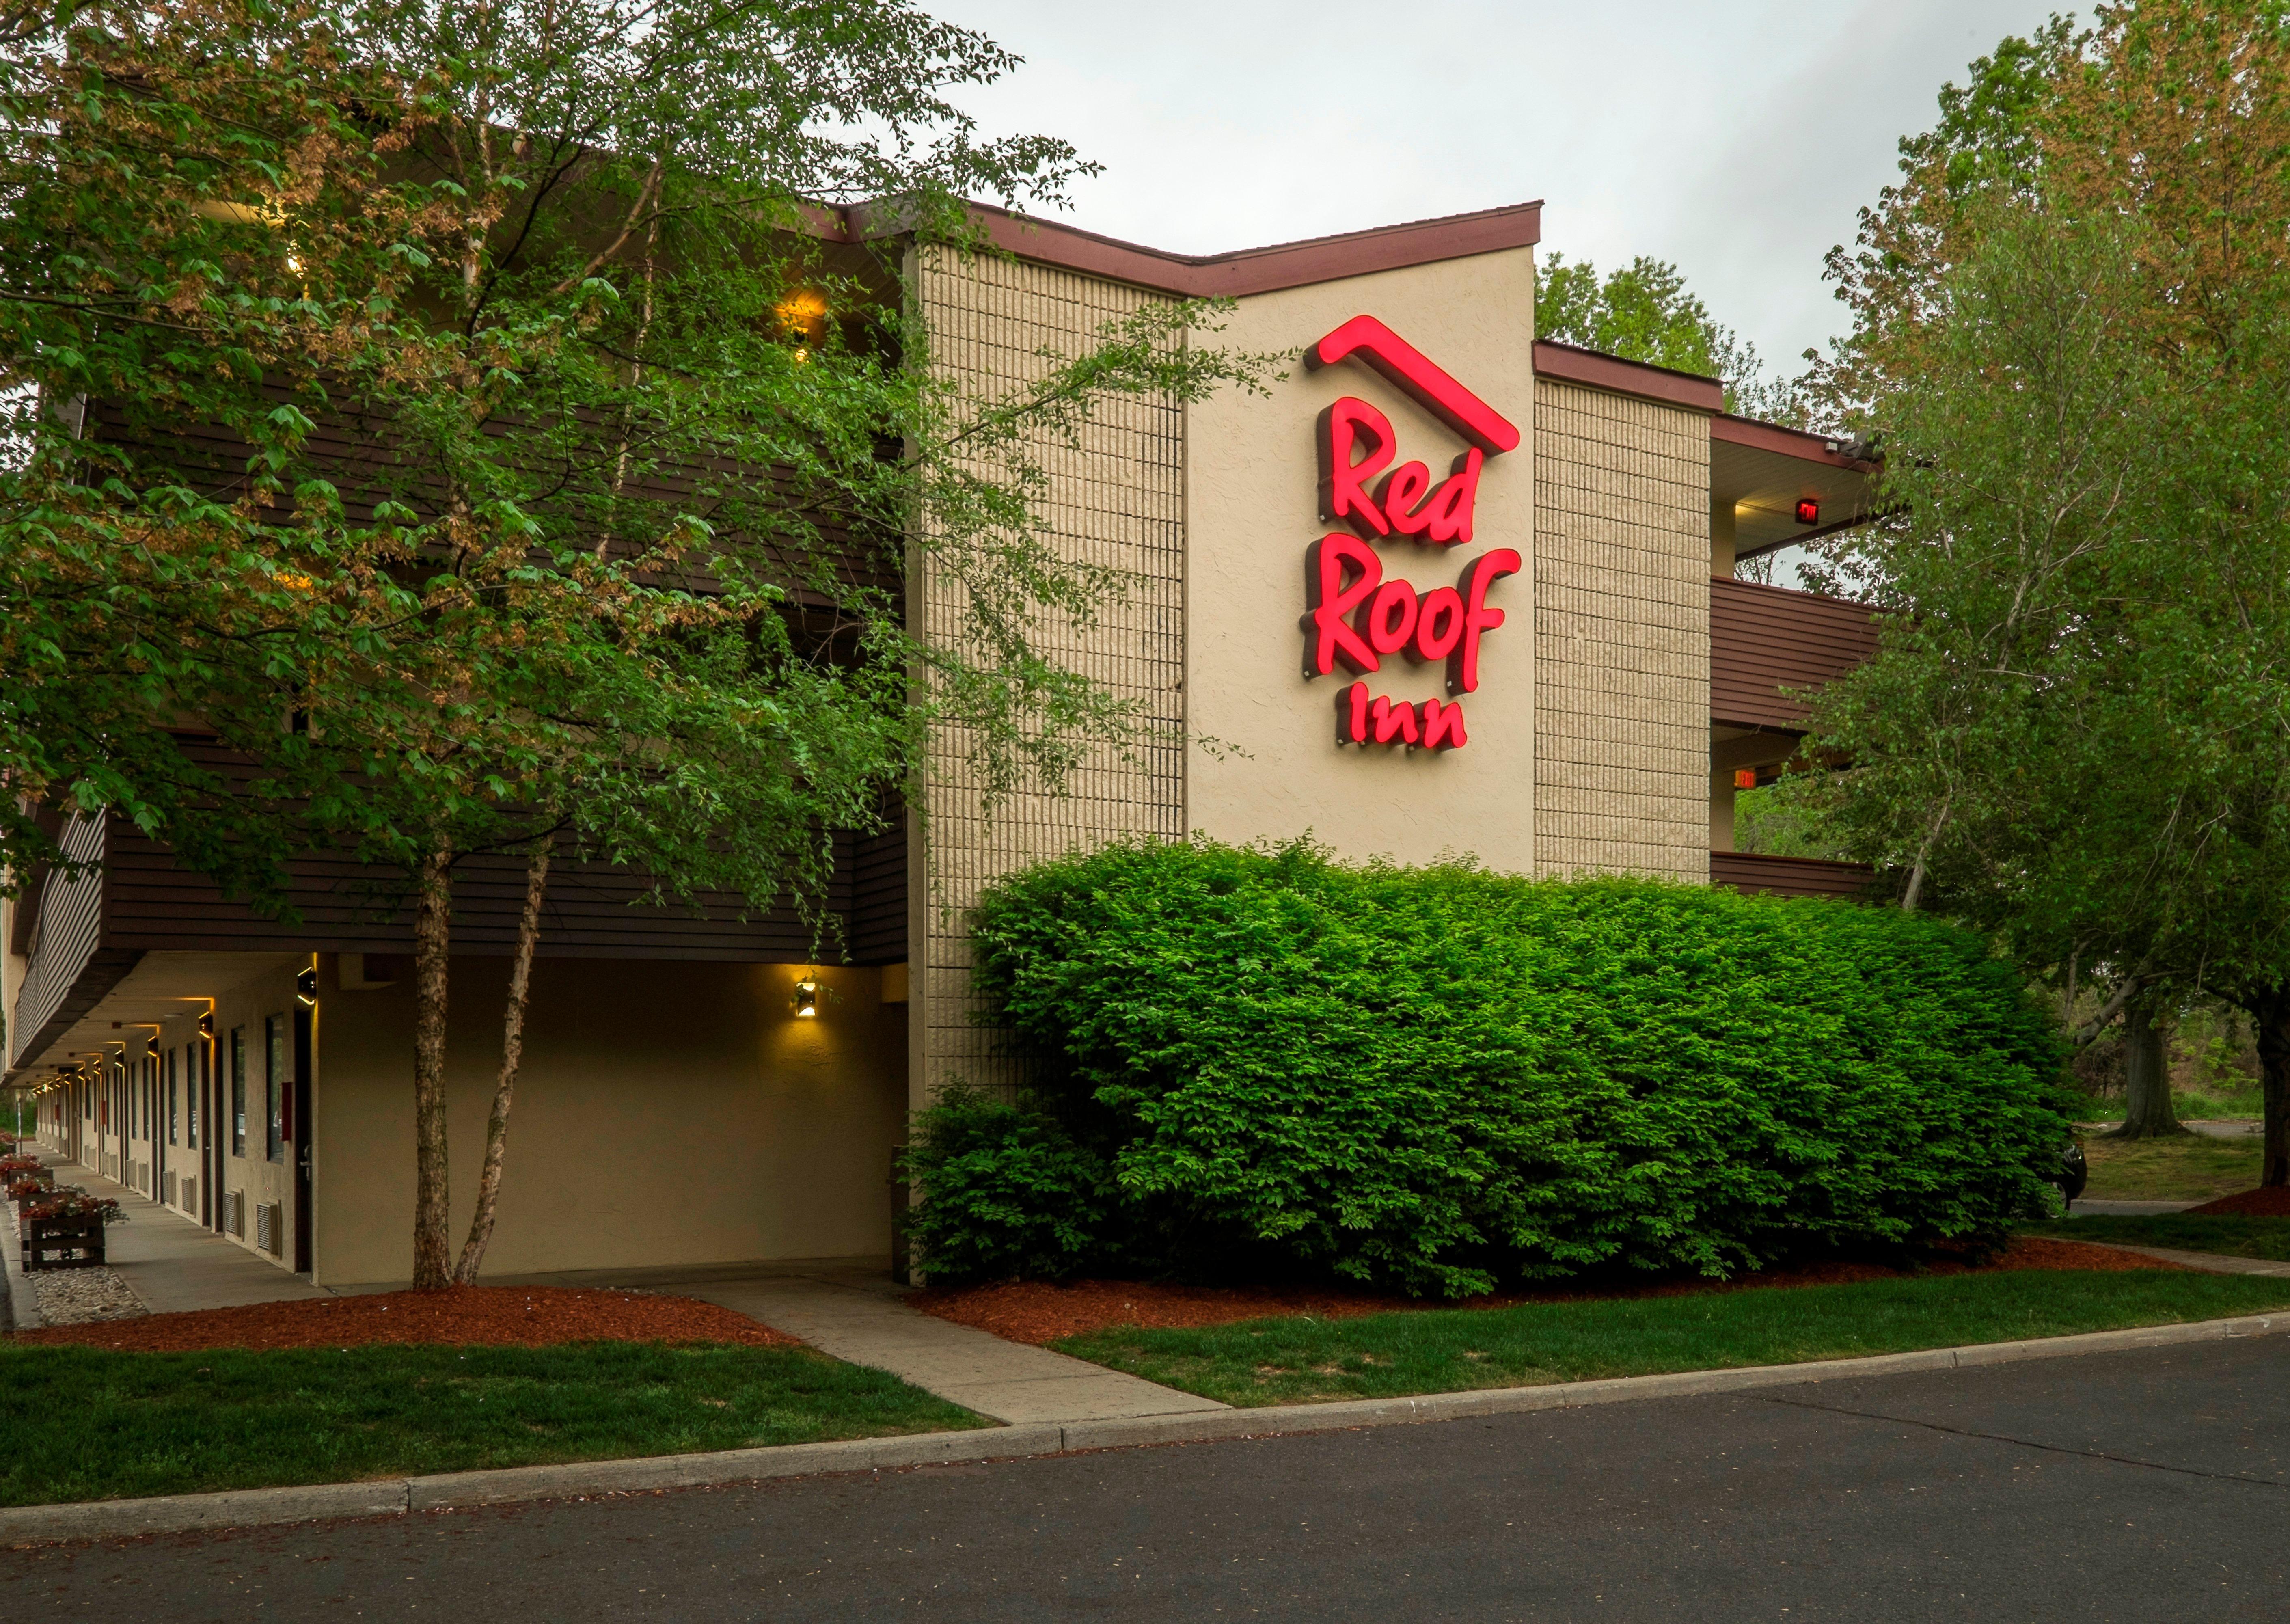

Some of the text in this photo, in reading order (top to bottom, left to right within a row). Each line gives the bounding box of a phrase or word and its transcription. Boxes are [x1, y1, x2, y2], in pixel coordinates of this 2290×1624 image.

[1330, 397, 1484, 543] Red
[1314, 533, 1521, 692] Roof
[1349, 682, 1467, 749] Inn
